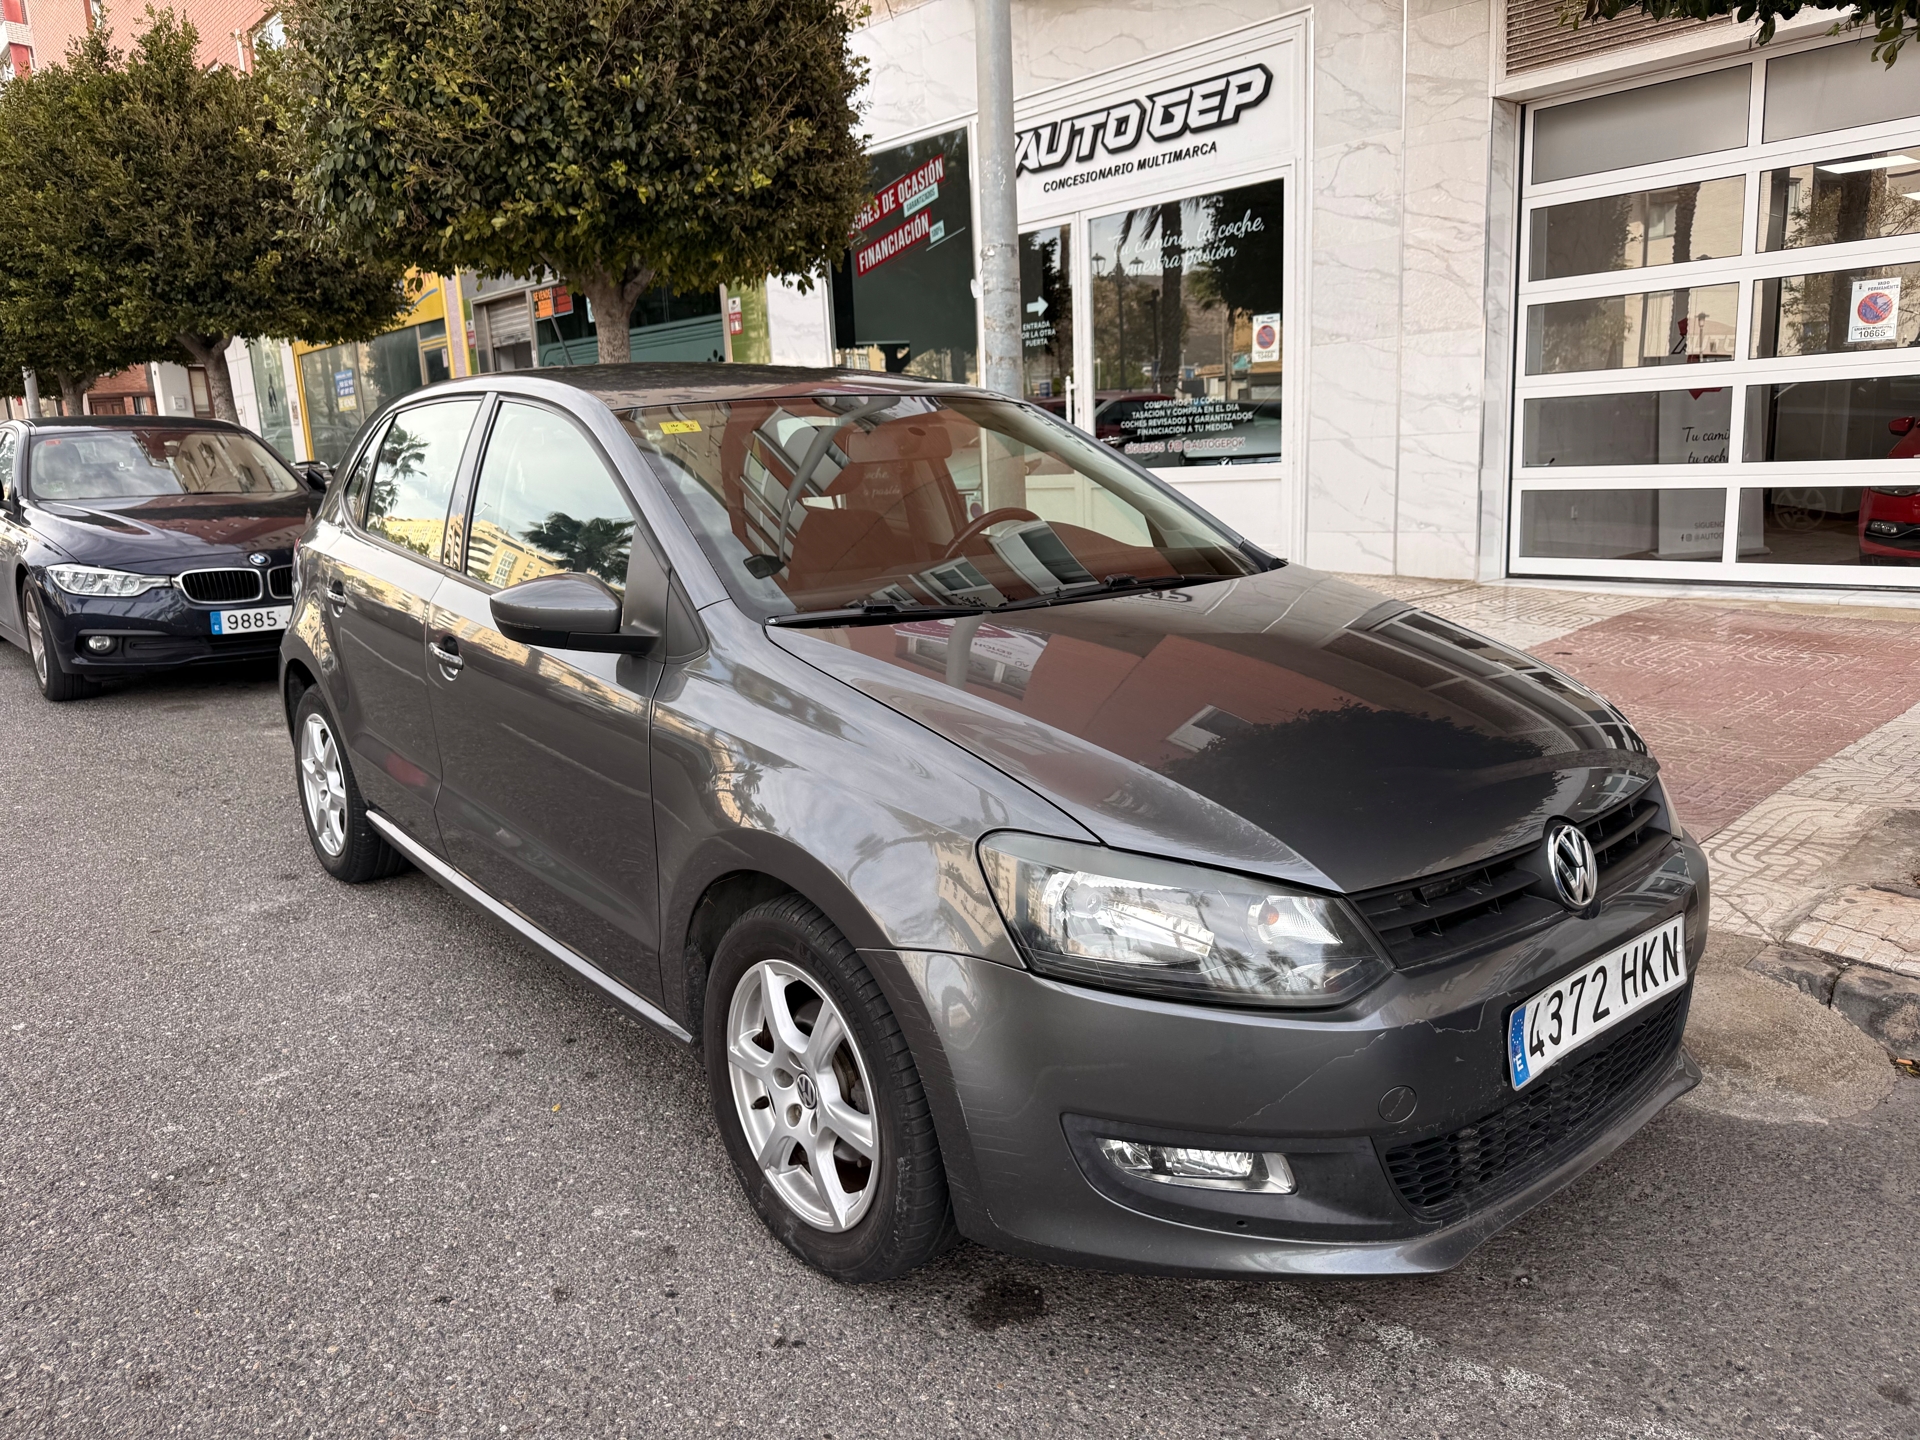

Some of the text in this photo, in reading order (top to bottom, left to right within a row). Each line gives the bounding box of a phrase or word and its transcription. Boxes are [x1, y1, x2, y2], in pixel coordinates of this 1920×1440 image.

[1014, 63, 1273, 178] AUTO GEP
[1043, 141, 1217, 193] CONCESIONARIO MULTIMARCA
[881, 189, 896, 214] DE
[897, 157, 944, 204] OCASIÓN
[1108, 234, 1131, 258] Tu
[1218, 208, 1265, 238] coche,
[858, 213, 929, 273] FINANCIACIÓN
[1125, 240, 1238, 275] nuestra pasión
[1021, 328, 1056, 340] OR LA OTRA
[1022, 320, 1050, 331] ENTRADA
[1858, 330, 1886, 338] 10665
[1025, 337, 1049, 347] PUERTA
[1132, 410, 1165, 419] TASACION
[1172, 406, 1203, 416] COMPRA
[1203, 405, 1215, 413] EN
[1215, 404, 1225, 412] EL
[1144, 399, 1188, 410] COMPRAMOS
[1120, 411, 1253, 429] COCHES REVISADOS Y GARANTIZADOS
[1137, 422, 1234, 436] FINANCIACION A TU MEDIDA
[1682, 426, 1730, 443] Tu cami
[1688, 448, 1728, 463] tu coch
[227, 611, 277, 630] 9885
[1528, 965, 1610, 1058] 4372
[1621, 925, 1681, 1005] HKN
